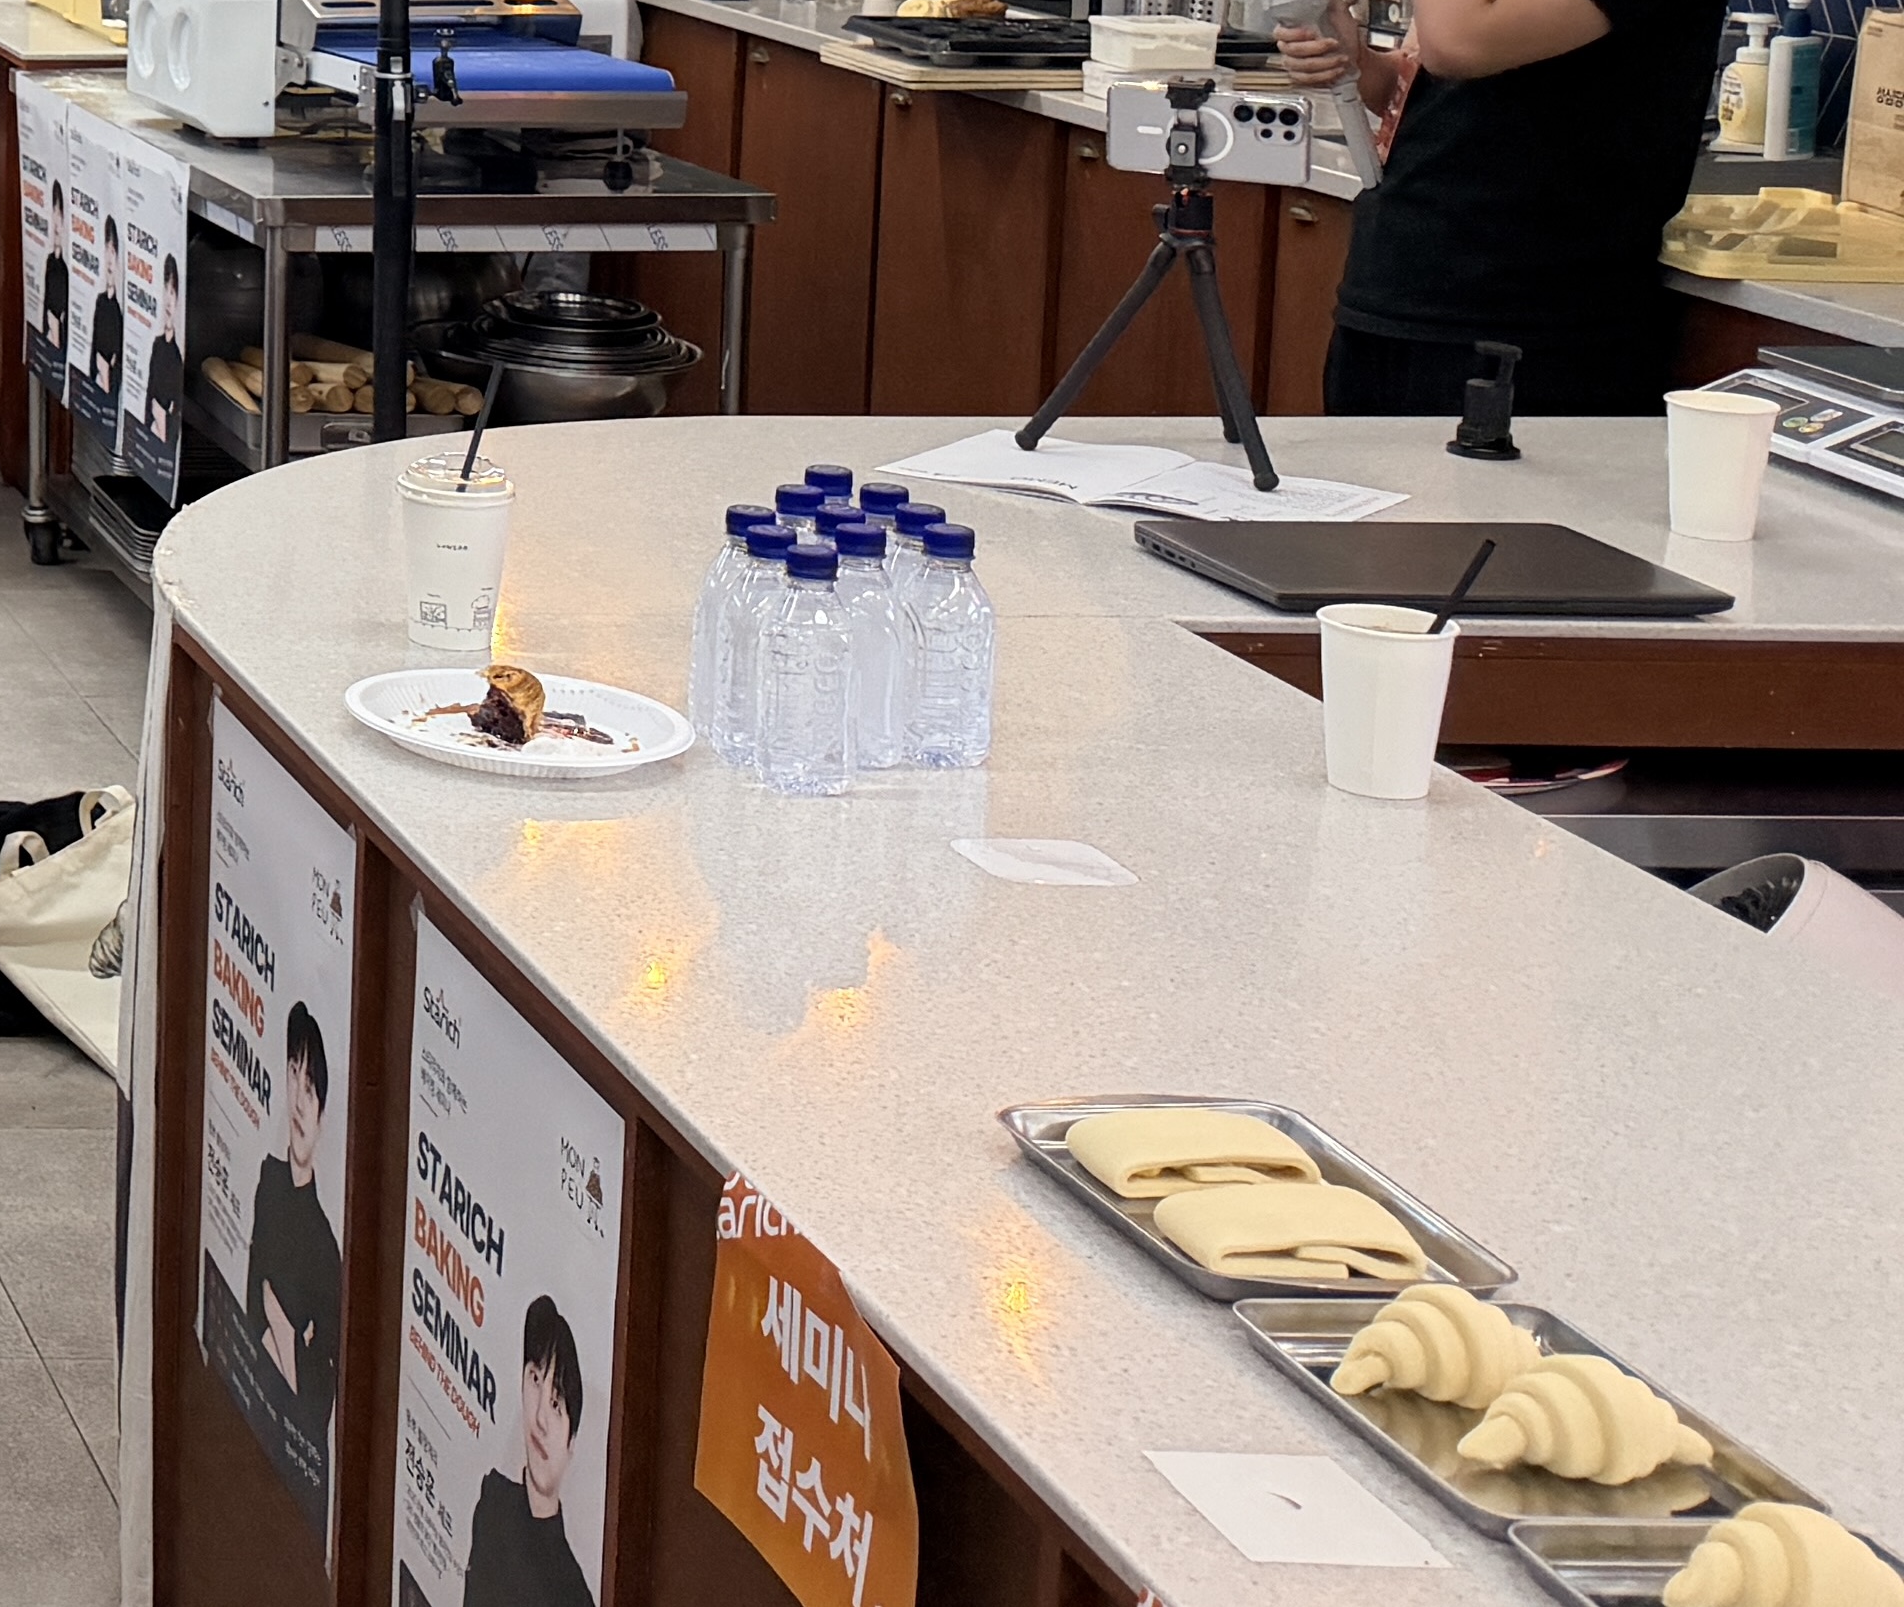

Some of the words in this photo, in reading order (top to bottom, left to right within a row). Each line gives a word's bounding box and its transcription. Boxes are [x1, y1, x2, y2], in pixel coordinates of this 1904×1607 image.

[127, 222, 158, 258] STARICH
[127, 251, 153, 284] BAKING
[213, 939, 265, 1039] BAKING
[214, 881, 276, 994] STARICH
[211, 997, 271, 1117] SEMINAR
[423, 986, 462, 1050] Starich
[417, 1130, 505, 1277] STARICH
[559, 1135, 586, 1178] MON
[560, 1176, 585, 1210] PEU
[415, 1196, 486, 1328] BAKING
[412, 1266, 498, 1426] SEMINAR
[760, 1274, 873, 1462] 세미나
[754, 1402, 874, 1607] 접수처
